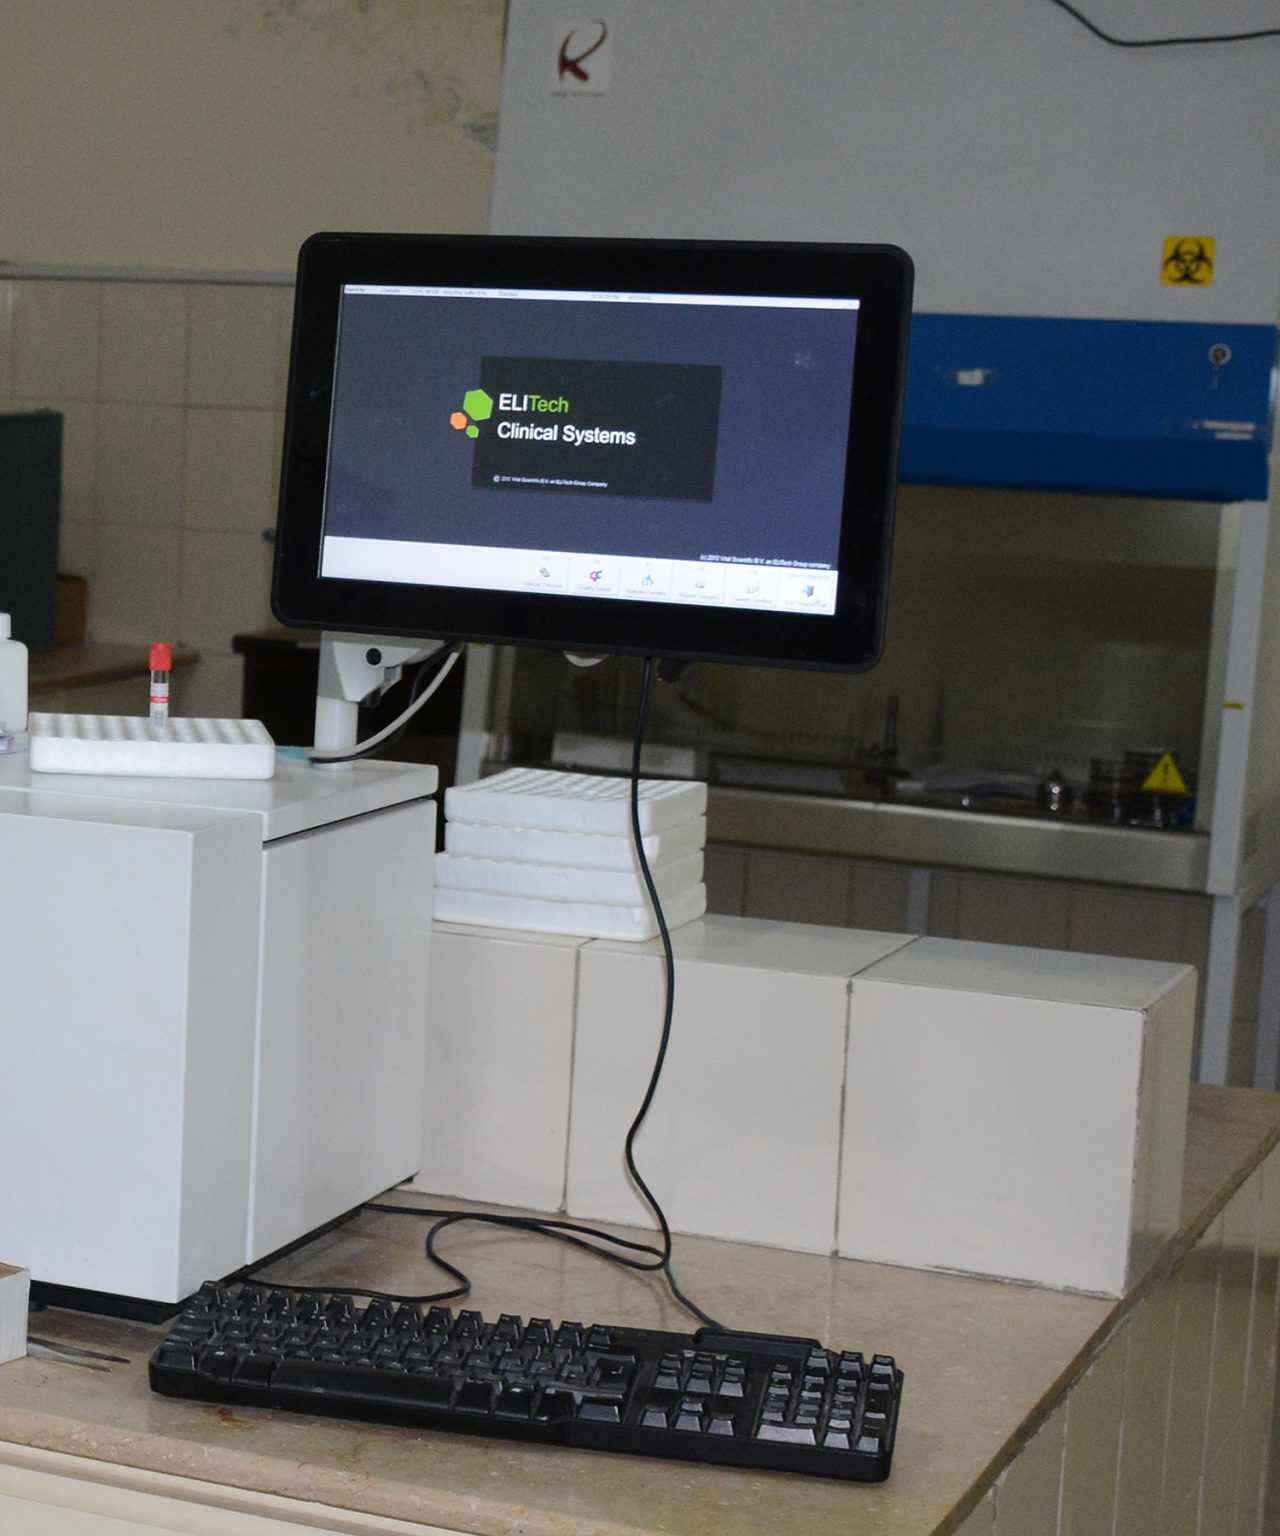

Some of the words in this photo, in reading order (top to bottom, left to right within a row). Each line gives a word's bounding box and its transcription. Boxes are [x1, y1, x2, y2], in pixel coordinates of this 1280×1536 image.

[498, 393, 569, 413] ELITech
[497, 421, 558, 441] Clinical
[562, 424, 636, 447] Systems
